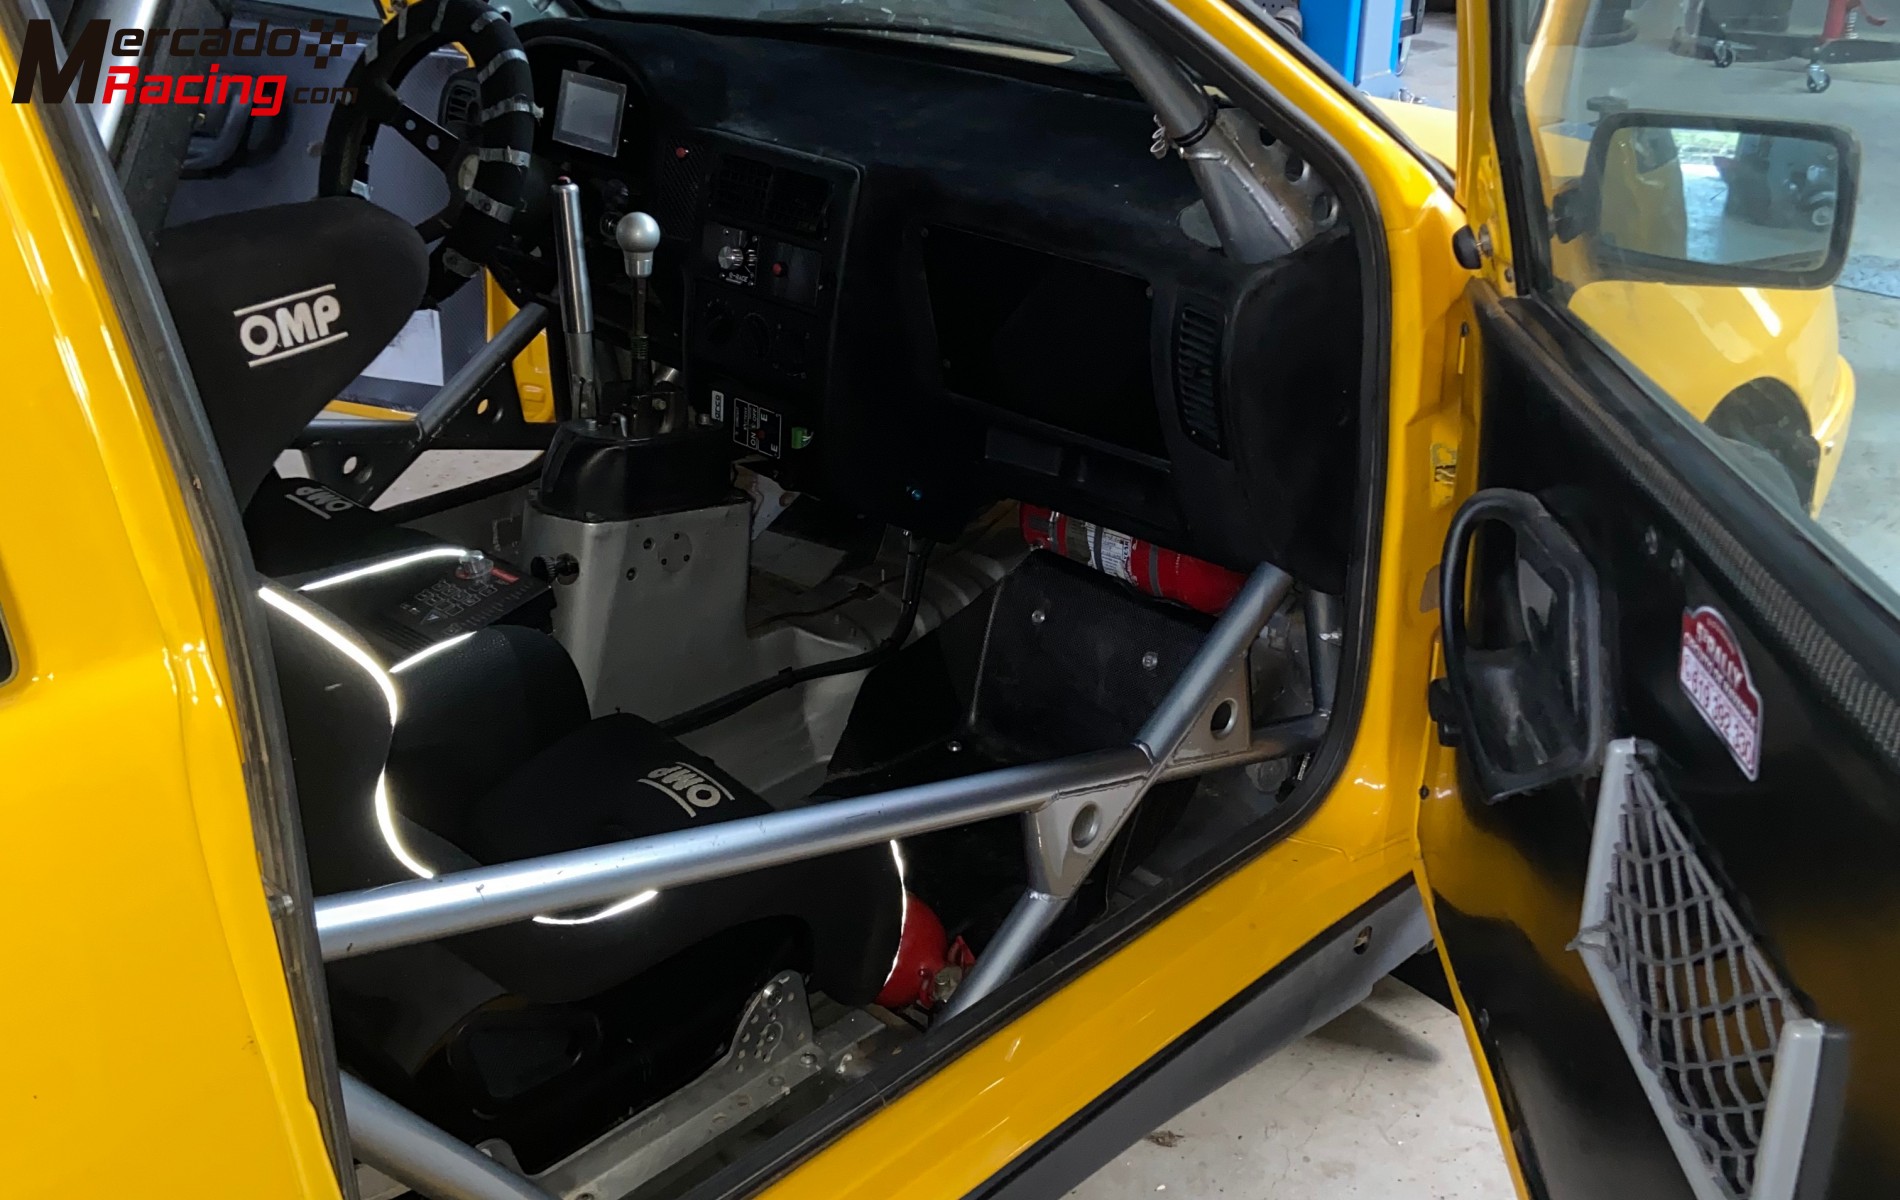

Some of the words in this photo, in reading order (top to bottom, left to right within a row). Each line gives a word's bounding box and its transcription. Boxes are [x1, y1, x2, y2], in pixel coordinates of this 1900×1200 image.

[240, 294, 341, 356] OMP
[296, 486, 354, 512] OMP
[647, 765, 721, 807] OMP
